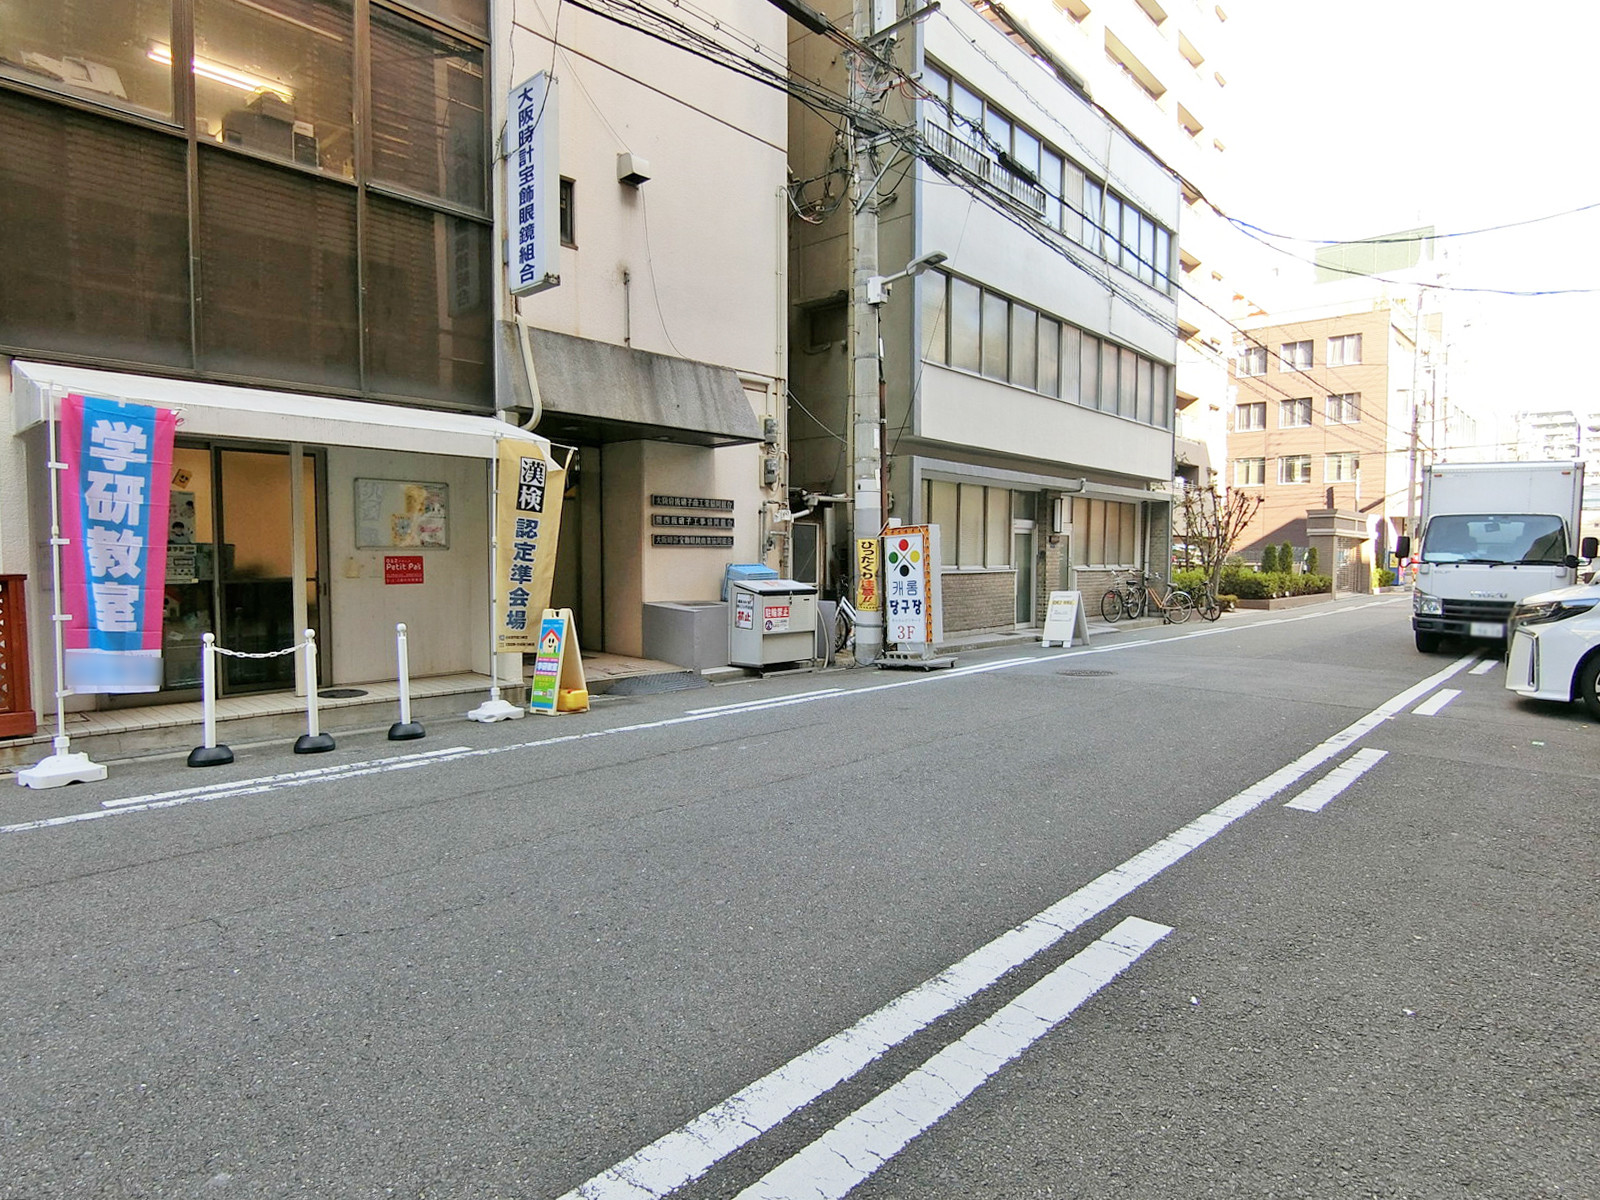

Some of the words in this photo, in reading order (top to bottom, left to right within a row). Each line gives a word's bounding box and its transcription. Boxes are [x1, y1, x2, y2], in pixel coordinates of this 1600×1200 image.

[518, 87, 536, 284] 大阪時計宝飾眼鏡組合
[518, 458, 546, 512] 漢検
[85, 419, 148, 632] 学研教室
[506, 518, 539, 631] 認定準会場
[892, 580, 918, 596] 캐롬
[890, 599, 922, 616] 당구장
[897, 626, 916, 639] 3F
